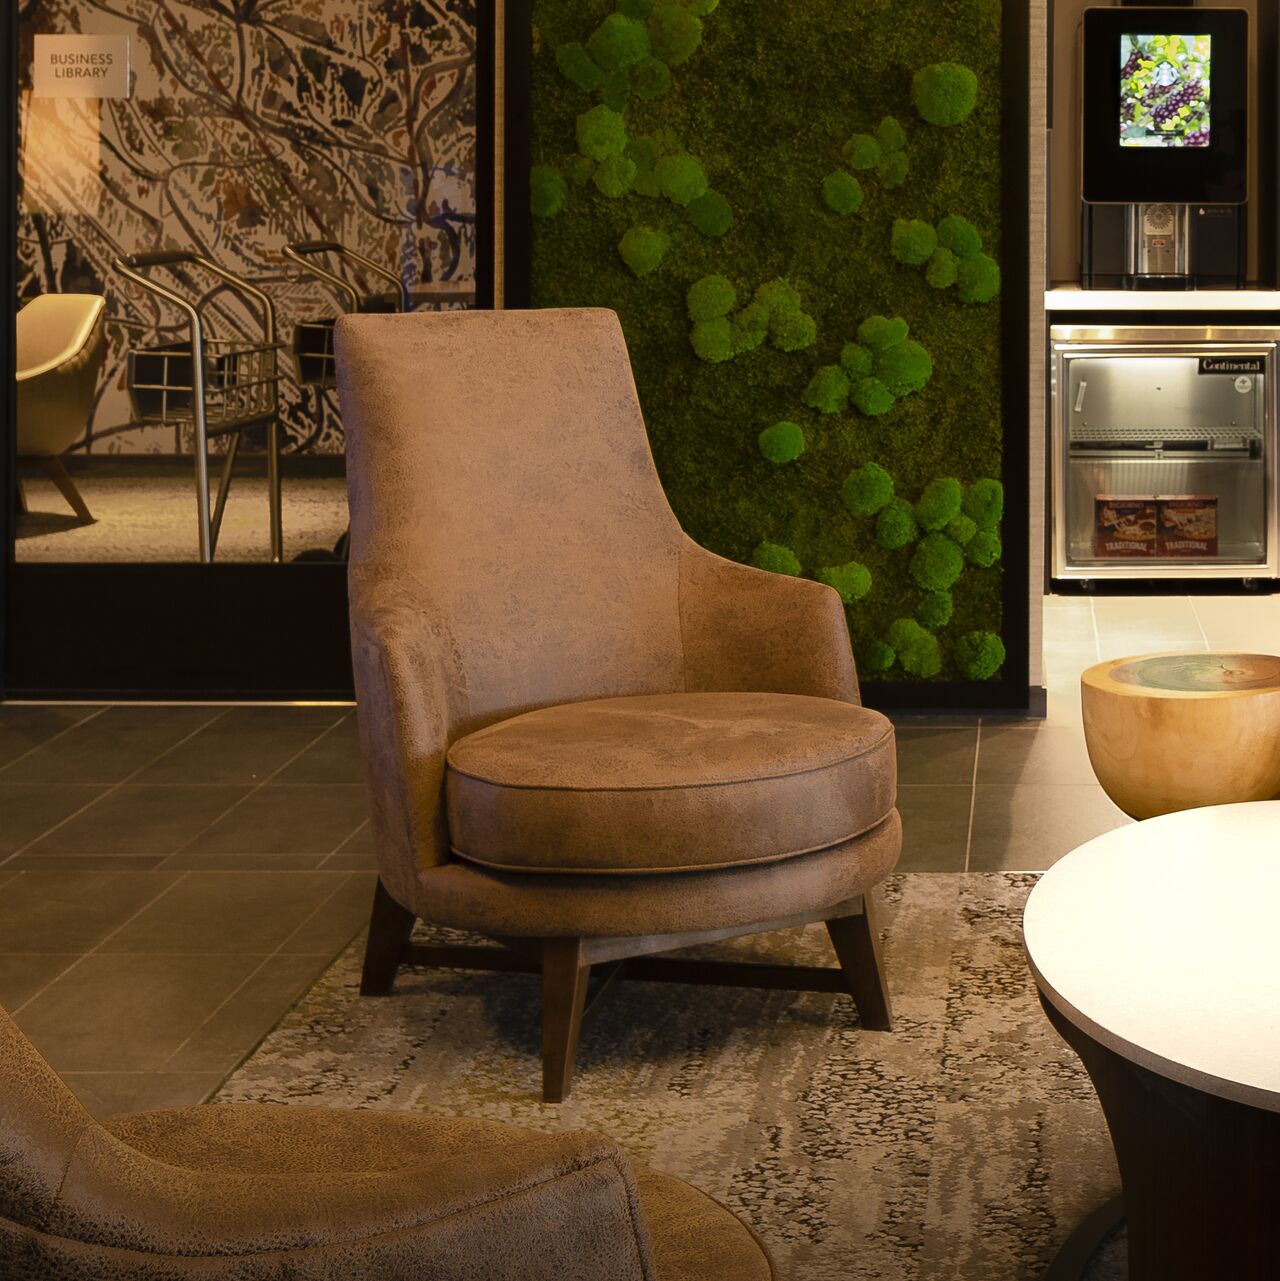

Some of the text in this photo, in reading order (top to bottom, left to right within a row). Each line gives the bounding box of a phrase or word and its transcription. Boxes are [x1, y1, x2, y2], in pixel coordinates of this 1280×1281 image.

[50, 53, 113, 65] BUSINESS
[55, 67, 108, 78] LIBRARY
[1203, 358, 1260, 370] Continental
[1105, 541, 1147, 552] TRADITIONAL
[1165, 541, 1207, 551] TRADITIONAL
